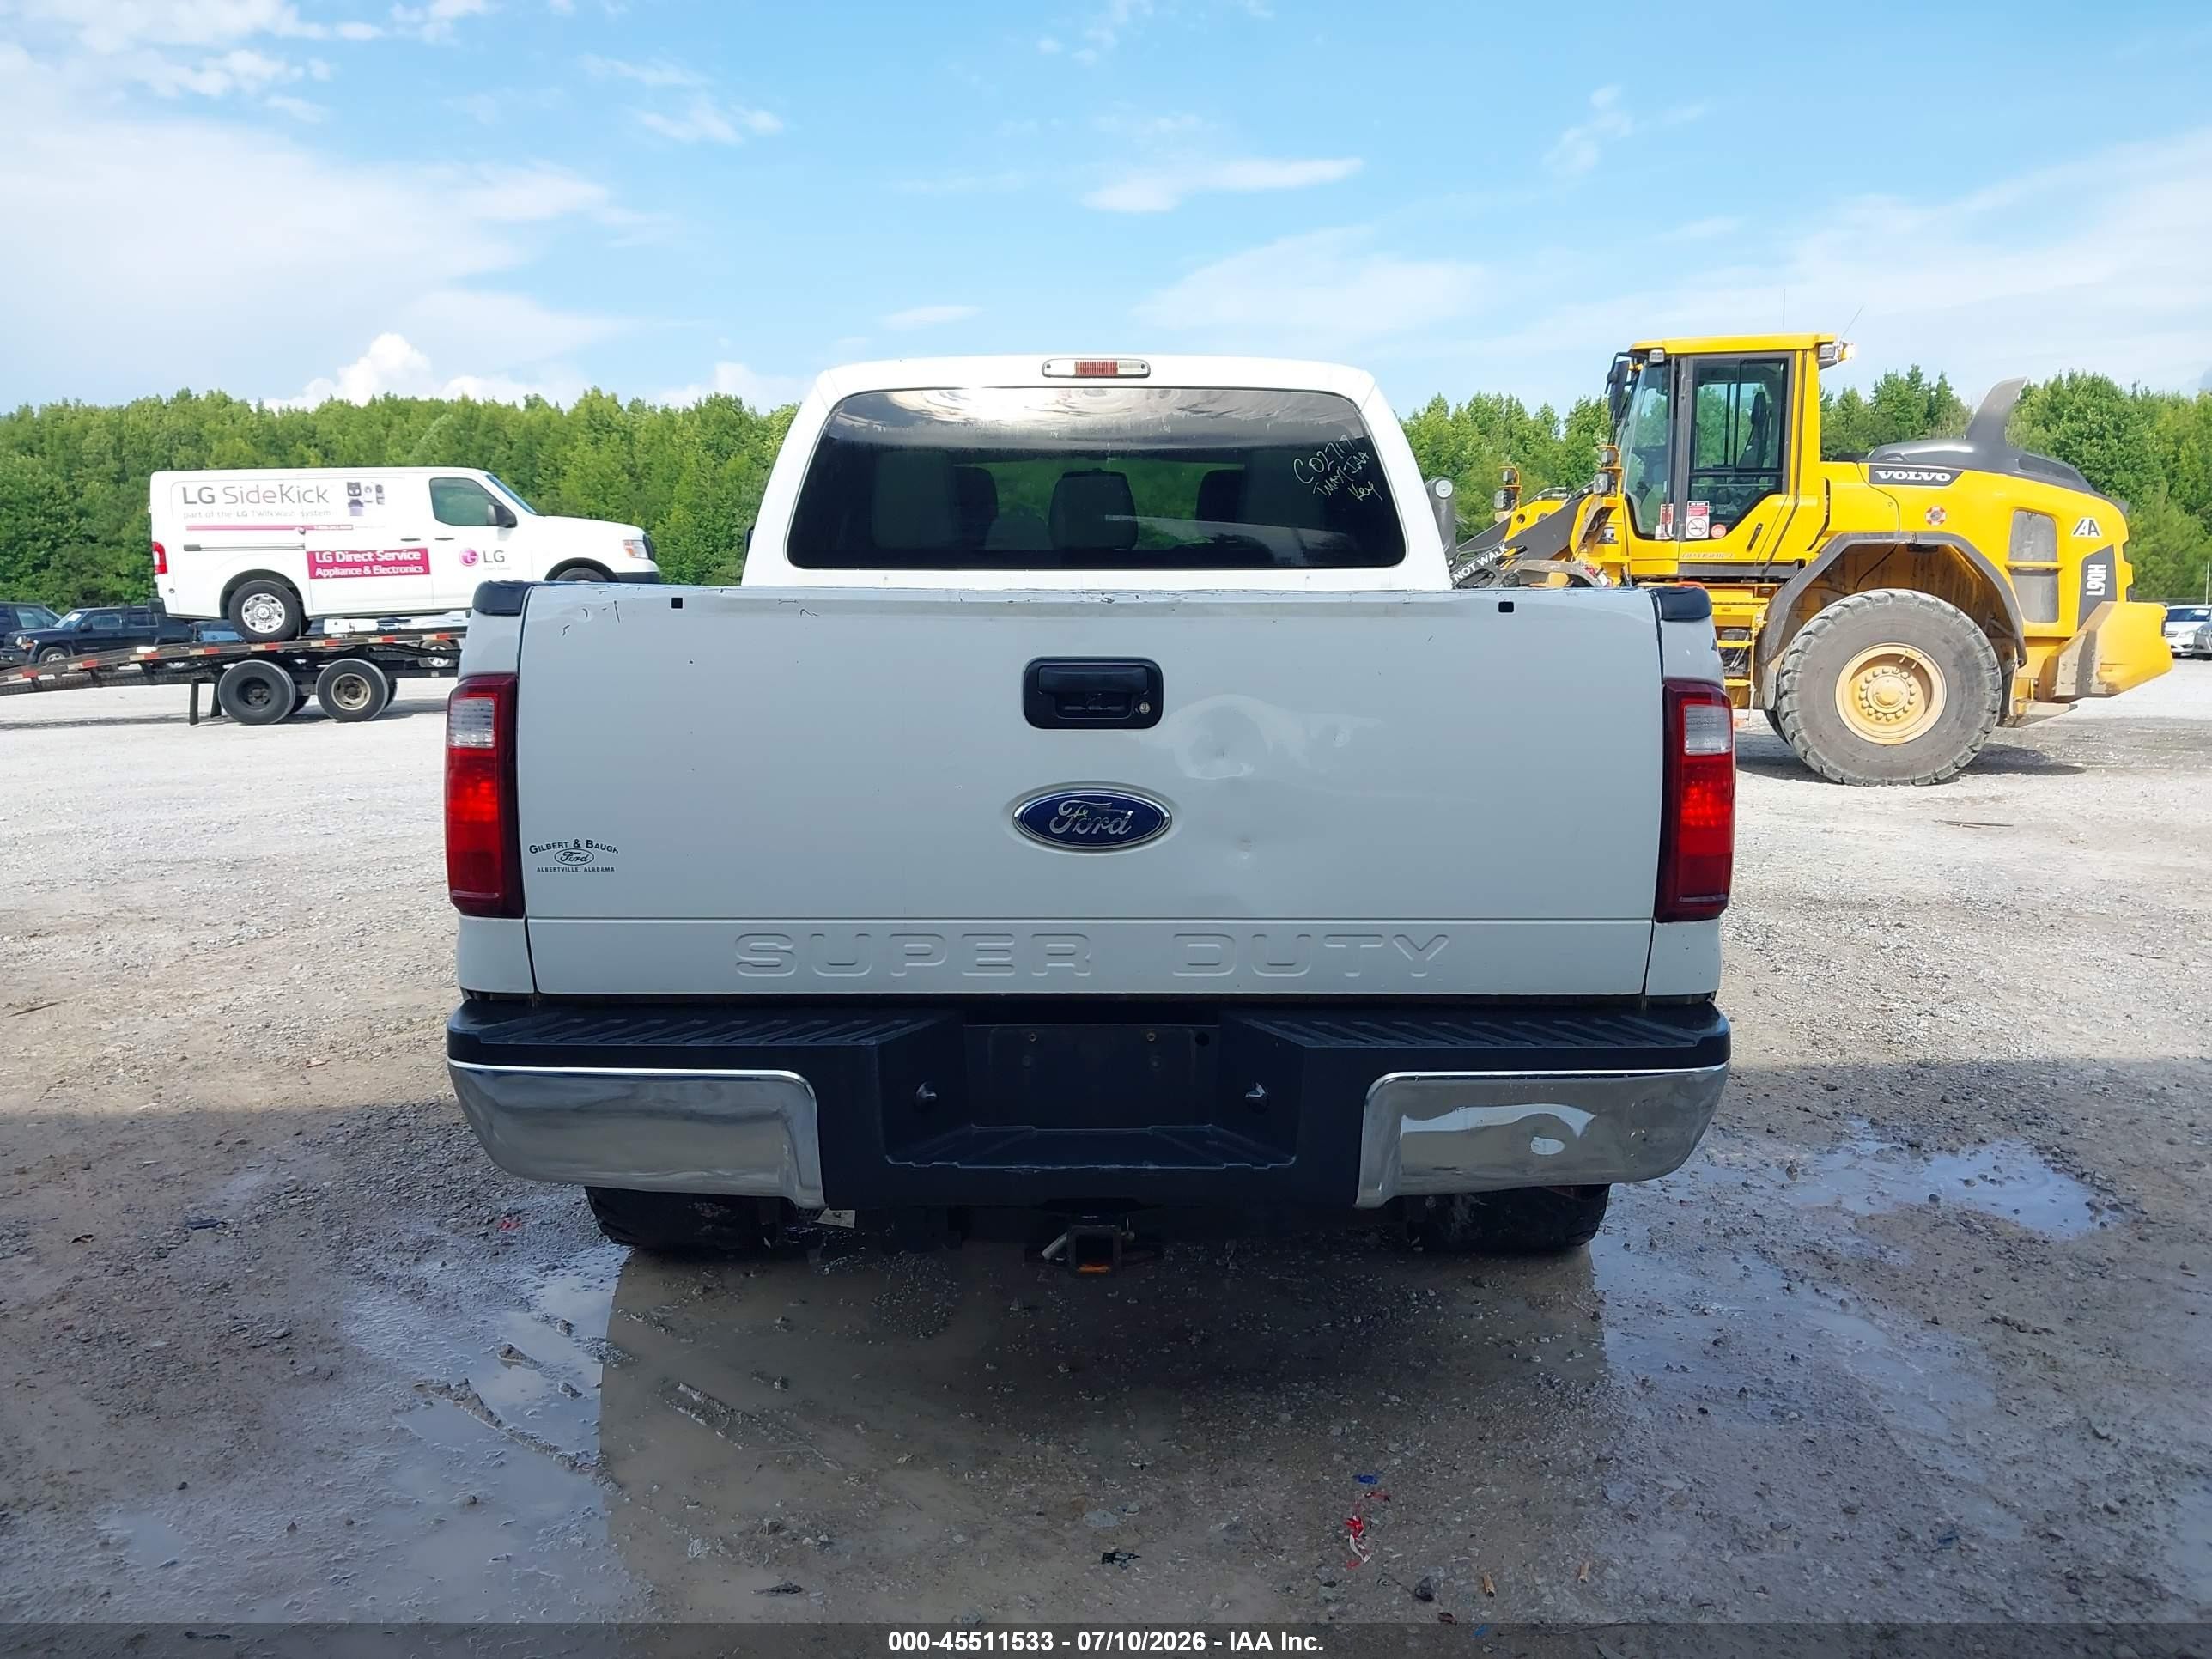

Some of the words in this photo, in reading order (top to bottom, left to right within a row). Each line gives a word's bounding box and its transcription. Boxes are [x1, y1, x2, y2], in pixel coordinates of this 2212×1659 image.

[1875, 471, 1951, 482] VOLVO
[182, 487, 216, 505] LG
[222, 484, 331, 505] SideKick
[1348, 481, 1383, 501] Key
[183, 511, 202, 520] part
[300, 510, 331, 520] system
[315, 551, 333, 563] LG
[335, 550, 374, 563] Direct
[377, 550, 421, 562] Service
[483, 550, 505, 563] LG
[1453, 562, 1476, 582] NOT
[1476, 544, 1509, 567] WALK
[315, 565, 362, 578] Appliance
[363, 566, 371, 574] &
[373, 564, 424, 574] Electronics
[2086, 564, 2107, 597] L90H
[1048, 799, 1134, 835] Ford
[573, 838, 581, 848] &
[560, 851, 590, 862] Ford
[734, 933, 1091, 977] SUPER
[1172, 933, 1449, 977] DUTY
